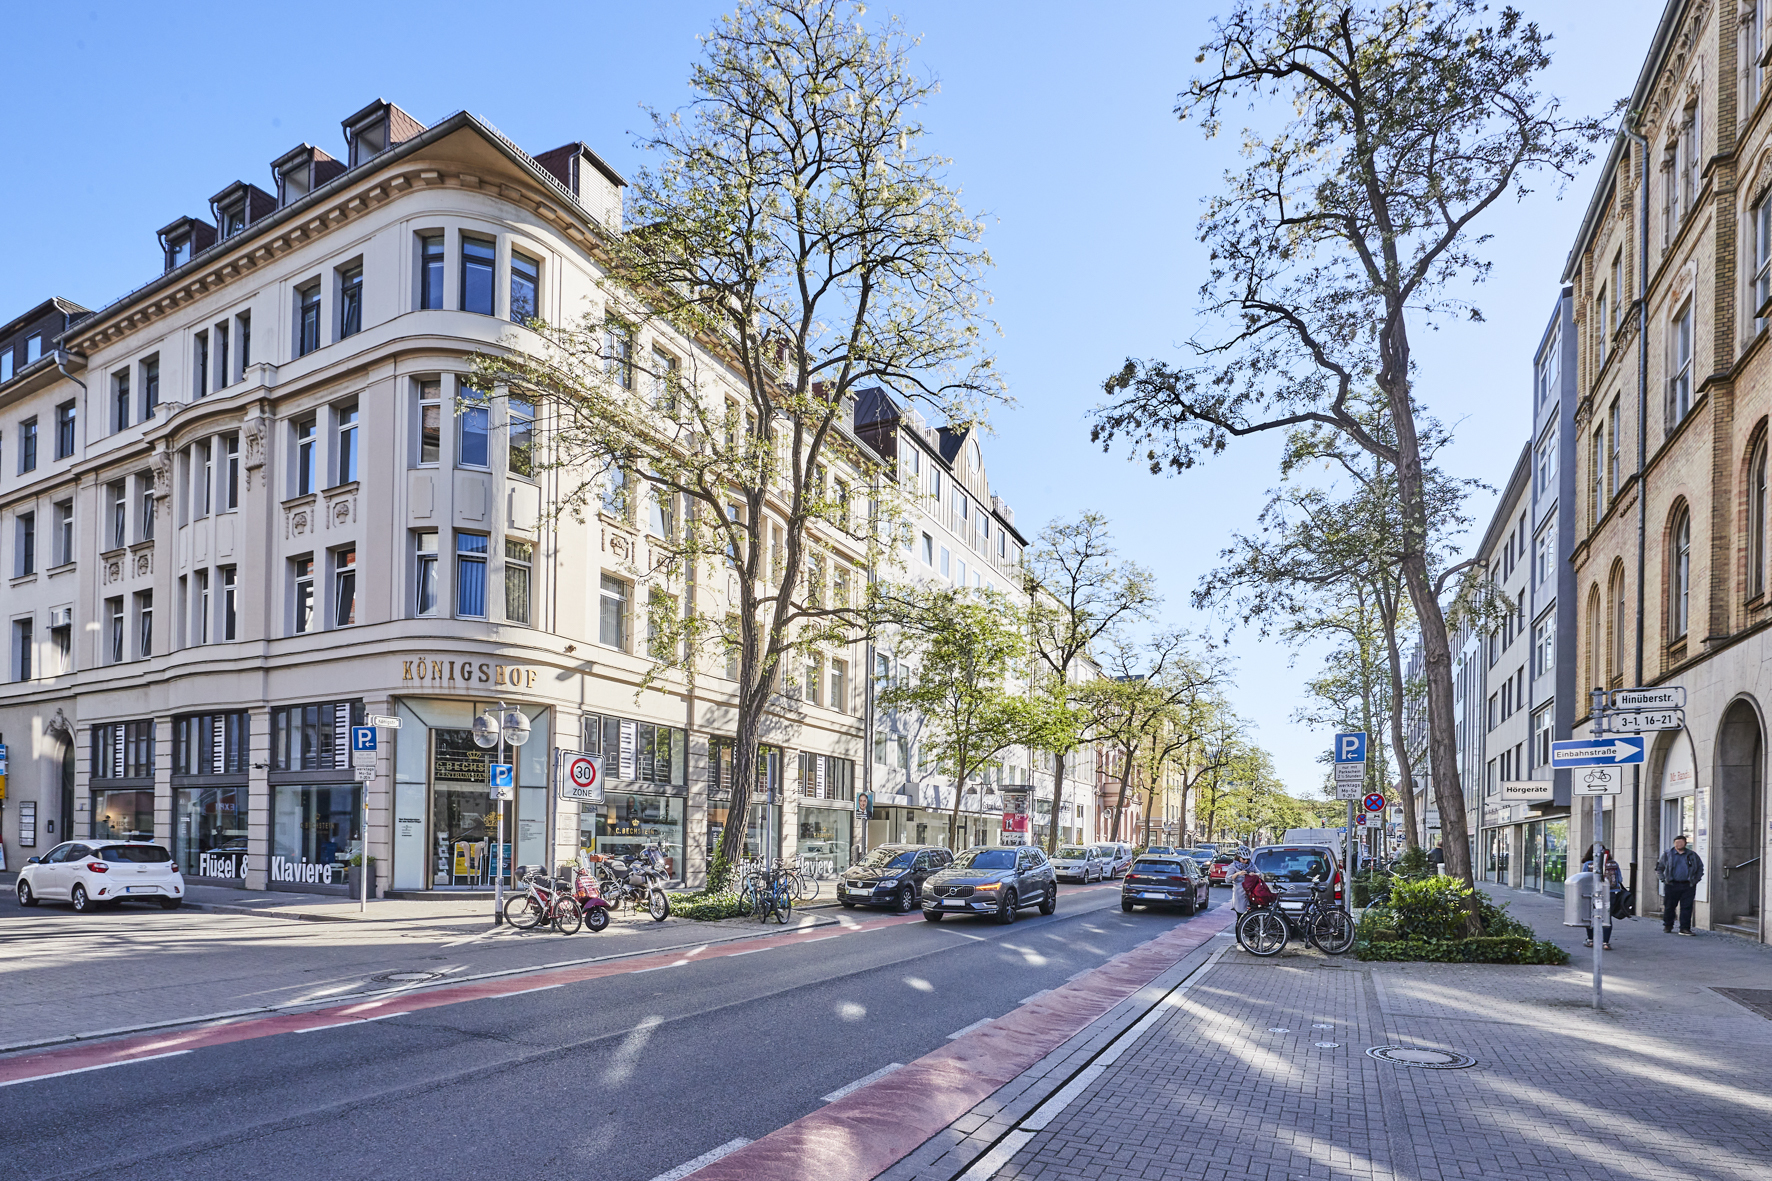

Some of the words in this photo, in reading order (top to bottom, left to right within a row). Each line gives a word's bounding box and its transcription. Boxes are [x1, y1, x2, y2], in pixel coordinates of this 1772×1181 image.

[402, 656, 537, 688] KÖNIGSHOF
[1621, 693, 1674, 705] Hinüberstr.
[1645, 714, 1672, 726] 16-21
[358, 730, 372, 748] P
[1342, 736, 1359, 759] P
[1556, 748, 1617, 758] Einbahnstraße
[496, 767, 508, 785] P
[575, 765, 591, 780] 30
[572, 788, 593, 798] ZONE
[1506, 786, 1548, 795] Hörgeräte
[200, 853, 236, 879] Flügel
[240, 854, 249, 879] &
[271, 856, 332, 884] Klaviere
